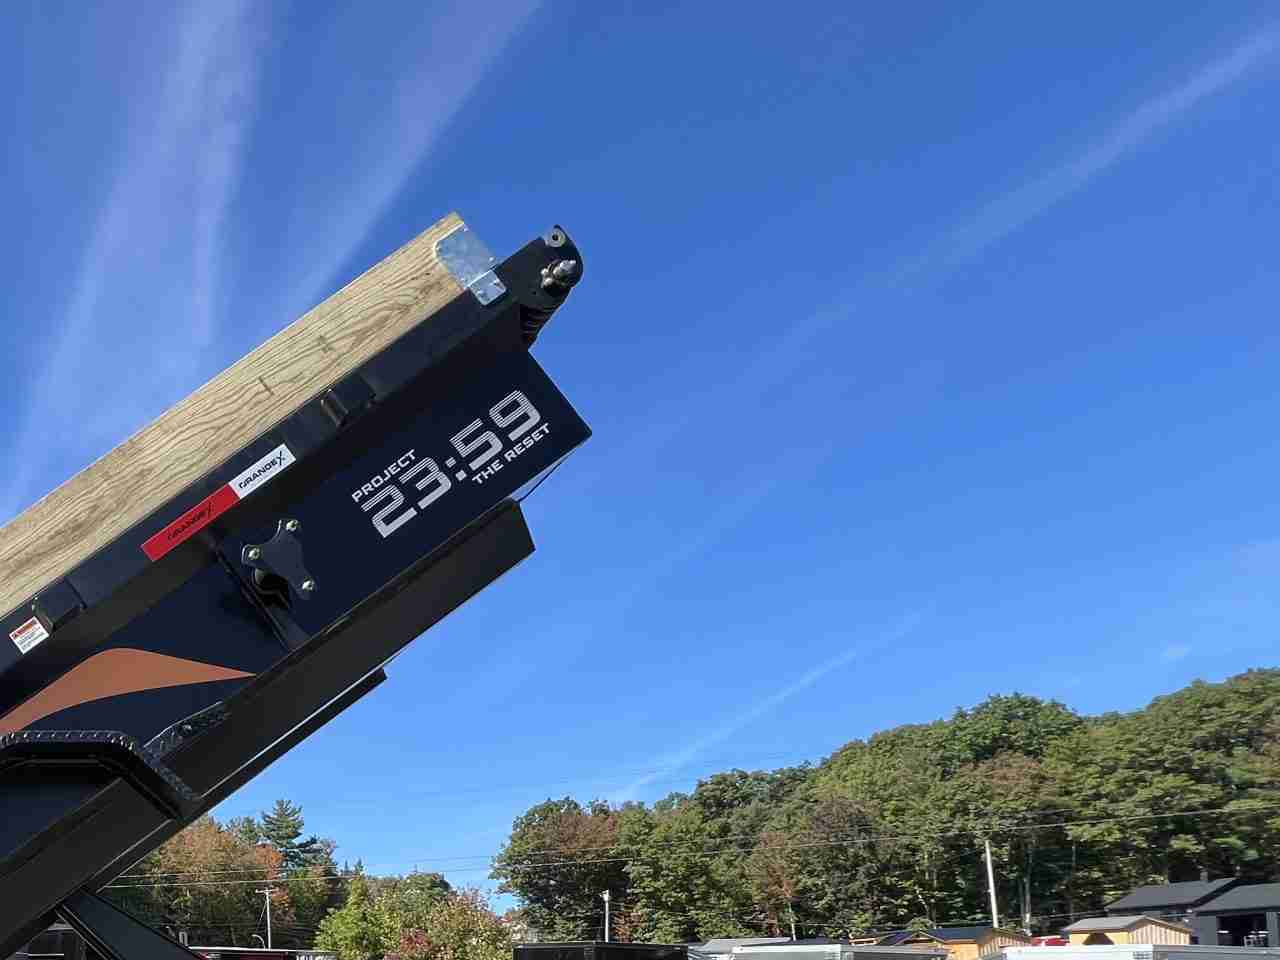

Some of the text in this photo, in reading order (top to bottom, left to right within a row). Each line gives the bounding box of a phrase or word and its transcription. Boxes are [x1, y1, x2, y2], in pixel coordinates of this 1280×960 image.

[352, 449, 416, 502] PROJECT
[361, 390, 541, 538] 23:59
[471, 423, 551, 485] THE RESET
